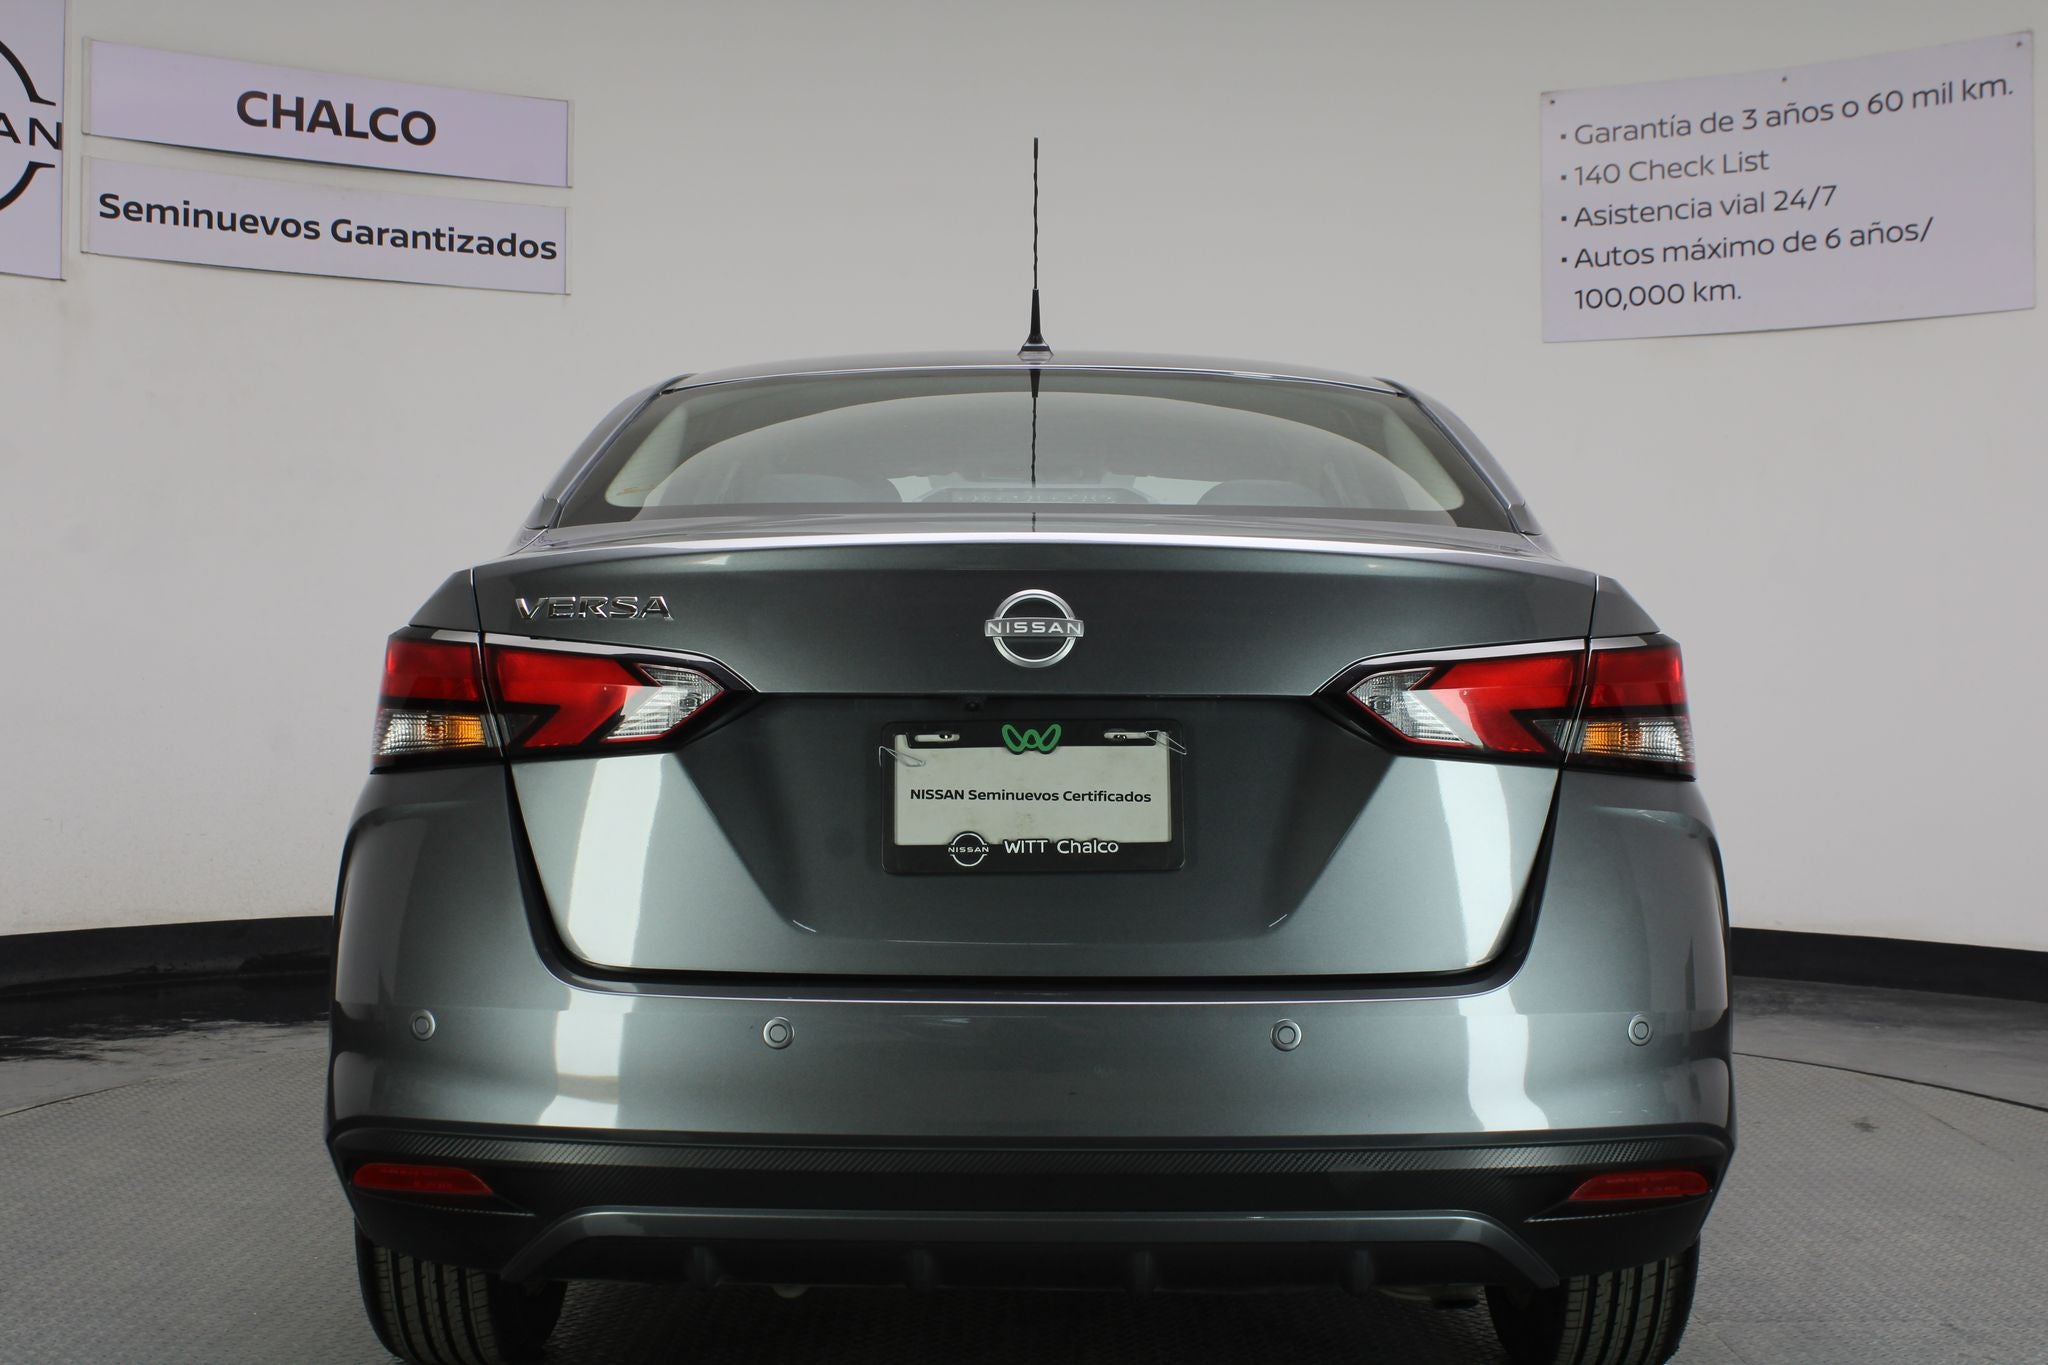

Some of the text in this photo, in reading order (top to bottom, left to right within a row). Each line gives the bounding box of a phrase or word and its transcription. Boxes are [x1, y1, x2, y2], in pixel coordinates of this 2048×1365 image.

[236, 90, 437, 146] CHALCO
[1574, 78, 2013, 145] Garantía de 3 años o 60 mil km.
[1574, 150, 1770, 186] 140 Check List
[1573, 184, 1837, 228] Asistencia vial 24/7
[99, 193, 557, 260] Seminuevos Garantizados
[1574, 216, 1934, 269] Autos máximo de 6 años/
[1574, 280, 1742, 311] 100,000 km.
[514, 595, 674, 621] VERSA
[986, 621, 1082, 635] NISSAN
[910, 788, 1152, 803] NISSAN Seminuevos Certificados
[948, 846, 989, 854] NISSAN
[1004, 839, 1119, 854] WITT Chalco
